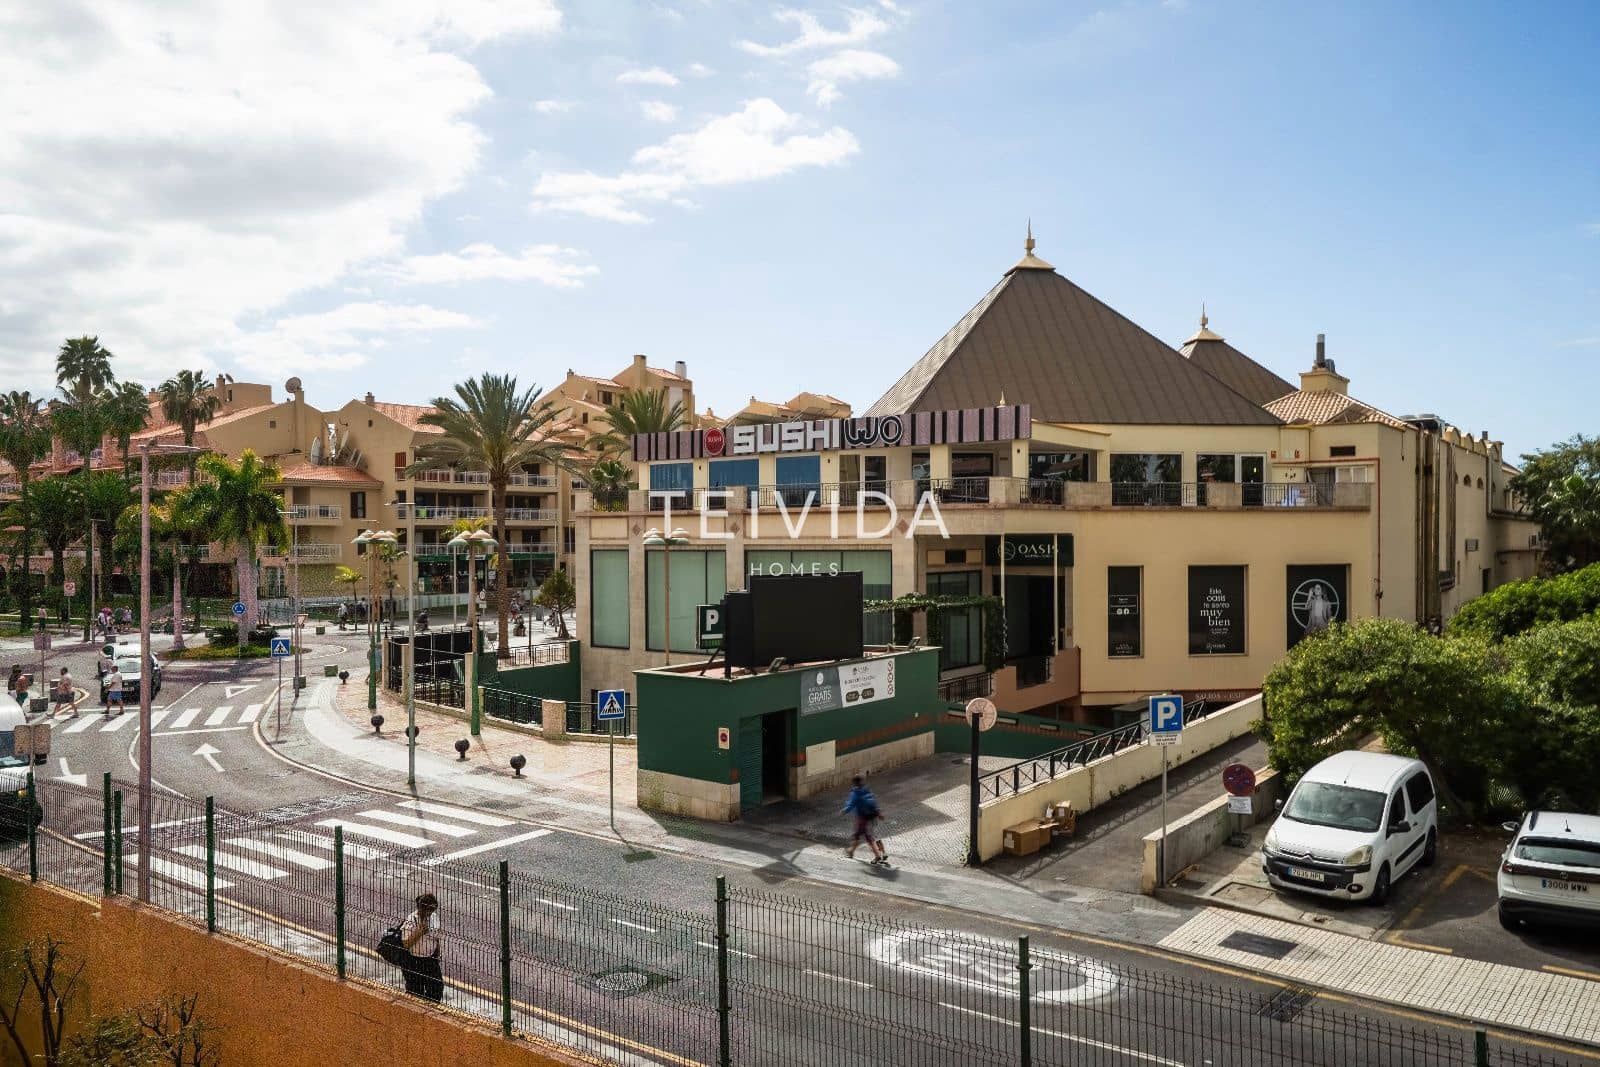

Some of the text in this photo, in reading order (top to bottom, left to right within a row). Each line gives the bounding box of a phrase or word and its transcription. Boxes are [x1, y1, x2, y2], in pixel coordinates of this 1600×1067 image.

[733, 418, 840, 454] SUSHI
[706, 609, 719, 631] P
[1200, 609, 1223, 619] muy
[1208, 615, 1231, 626] bien
[808, 690, 832, 704] GRATIS
[1157, 701, 1177, 729] P
